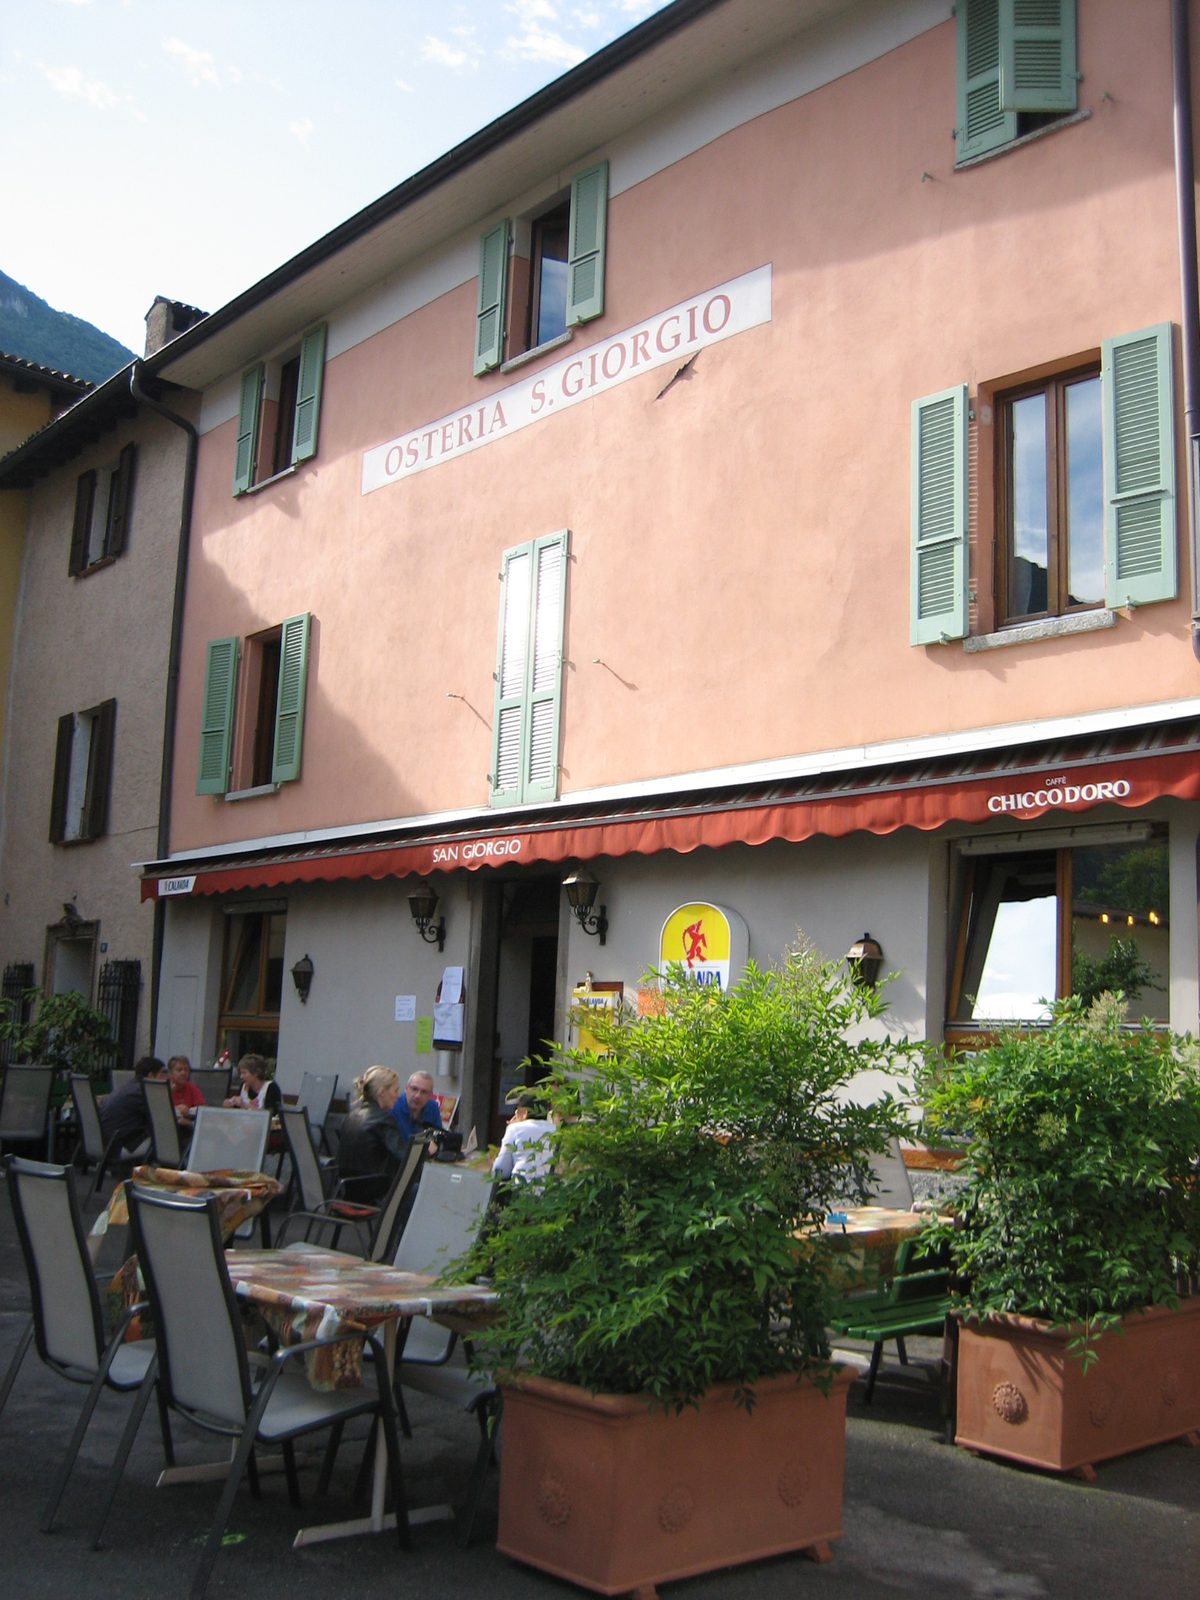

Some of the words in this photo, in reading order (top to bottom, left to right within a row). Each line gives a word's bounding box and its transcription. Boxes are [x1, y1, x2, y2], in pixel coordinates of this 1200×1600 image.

[384, 400, 508, 477] OSTERIA
[530, 379, 554, 414] S.
[561, 294, 731, 398] GIORGIO
[987, 788, 1063, 813] CHICCO
[1065, 780, 1131, 804] D'ORO
[432, 846, 459, 863] SAN
[462, 839, 521, 859] GIORGIO
